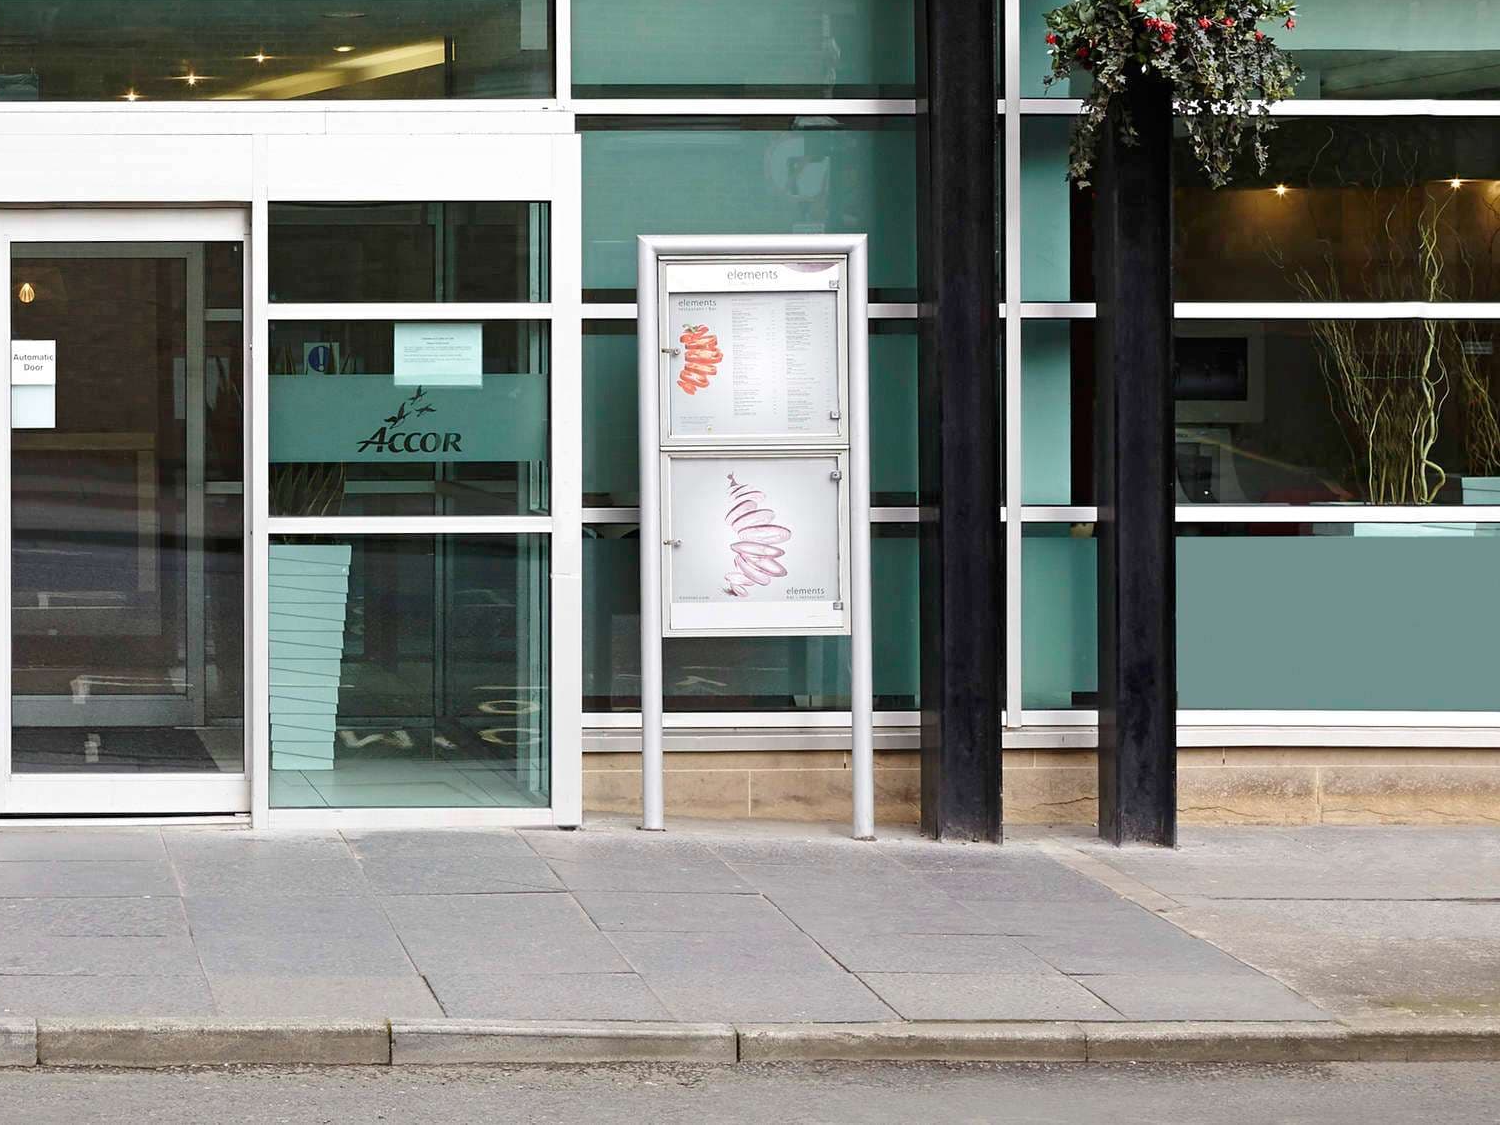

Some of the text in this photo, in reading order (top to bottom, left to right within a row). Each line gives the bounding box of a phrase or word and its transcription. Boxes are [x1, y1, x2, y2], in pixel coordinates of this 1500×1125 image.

[727, 269, 779, 280] elements
[678, 299, 717, 307] elements
[356, 427, 462, 453] ACCOR
[786, 586, 825, 595] elements
